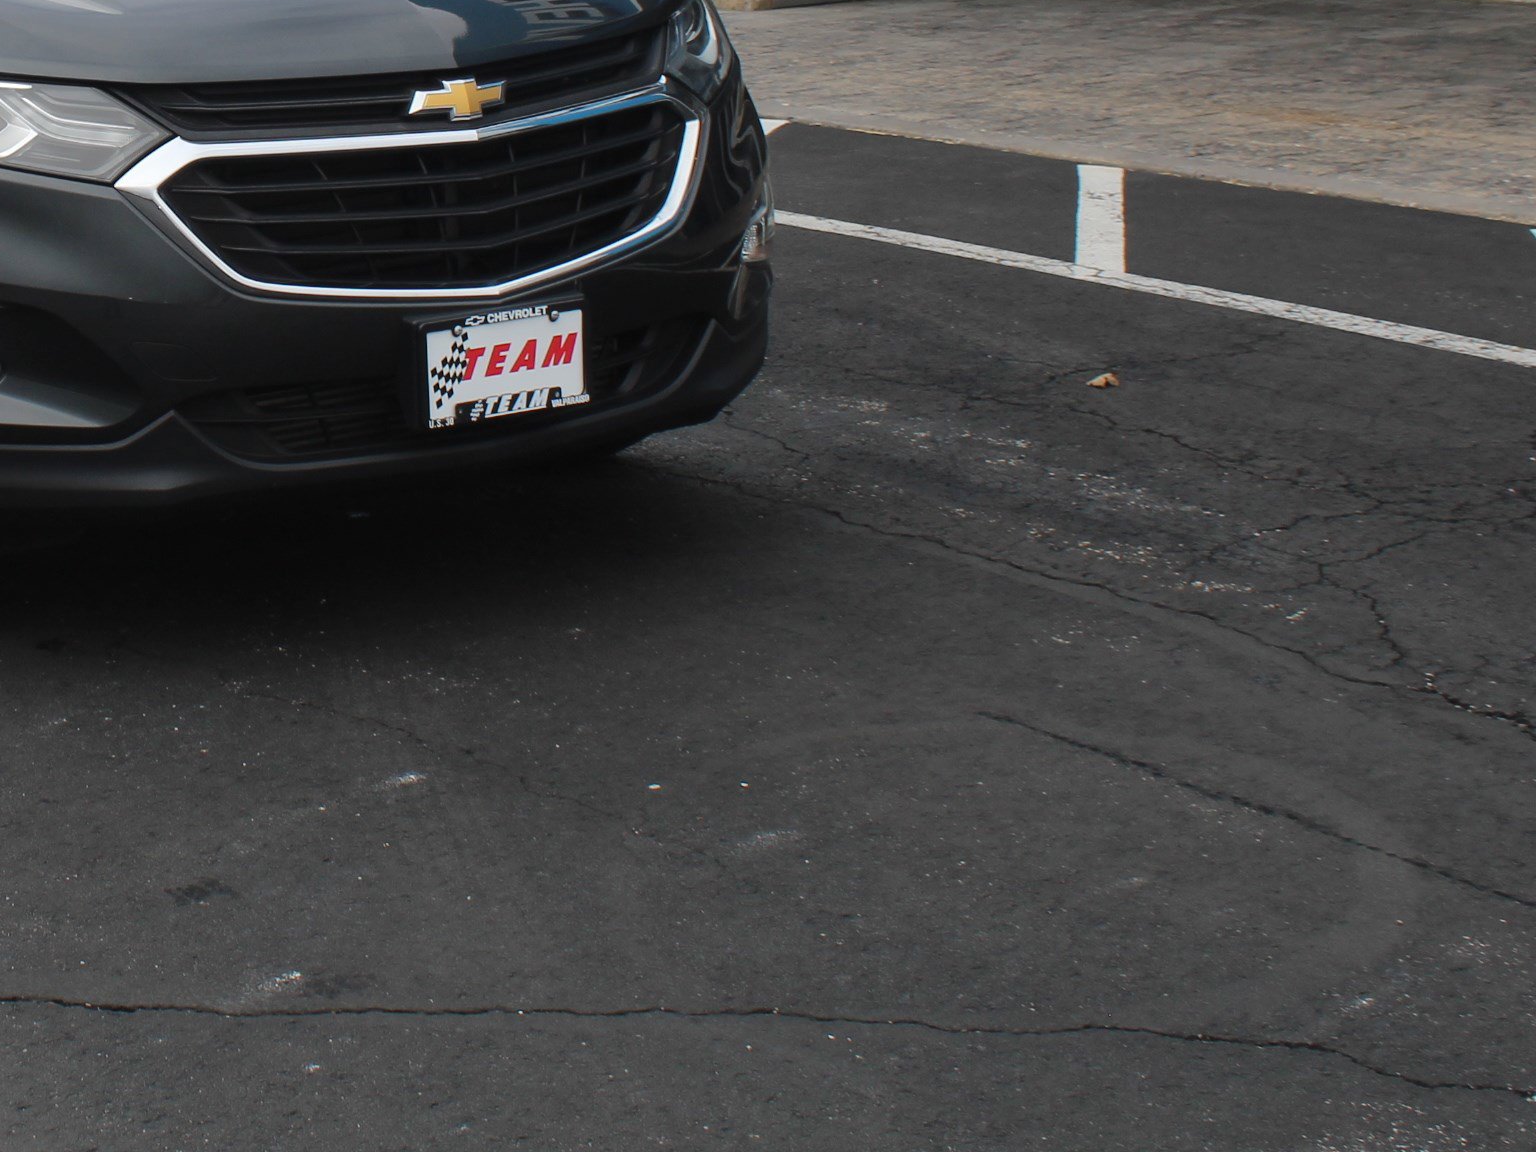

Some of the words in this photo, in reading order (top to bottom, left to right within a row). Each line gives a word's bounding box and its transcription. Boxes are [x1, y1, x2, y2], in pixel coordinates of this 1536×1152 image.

[486, 305, 548, 324] CHEVROLET
[462, 332, 578, 381] TEAM
[484, 387, 550, 417] TEAM
[429, 419, 445, 429] U.S.
